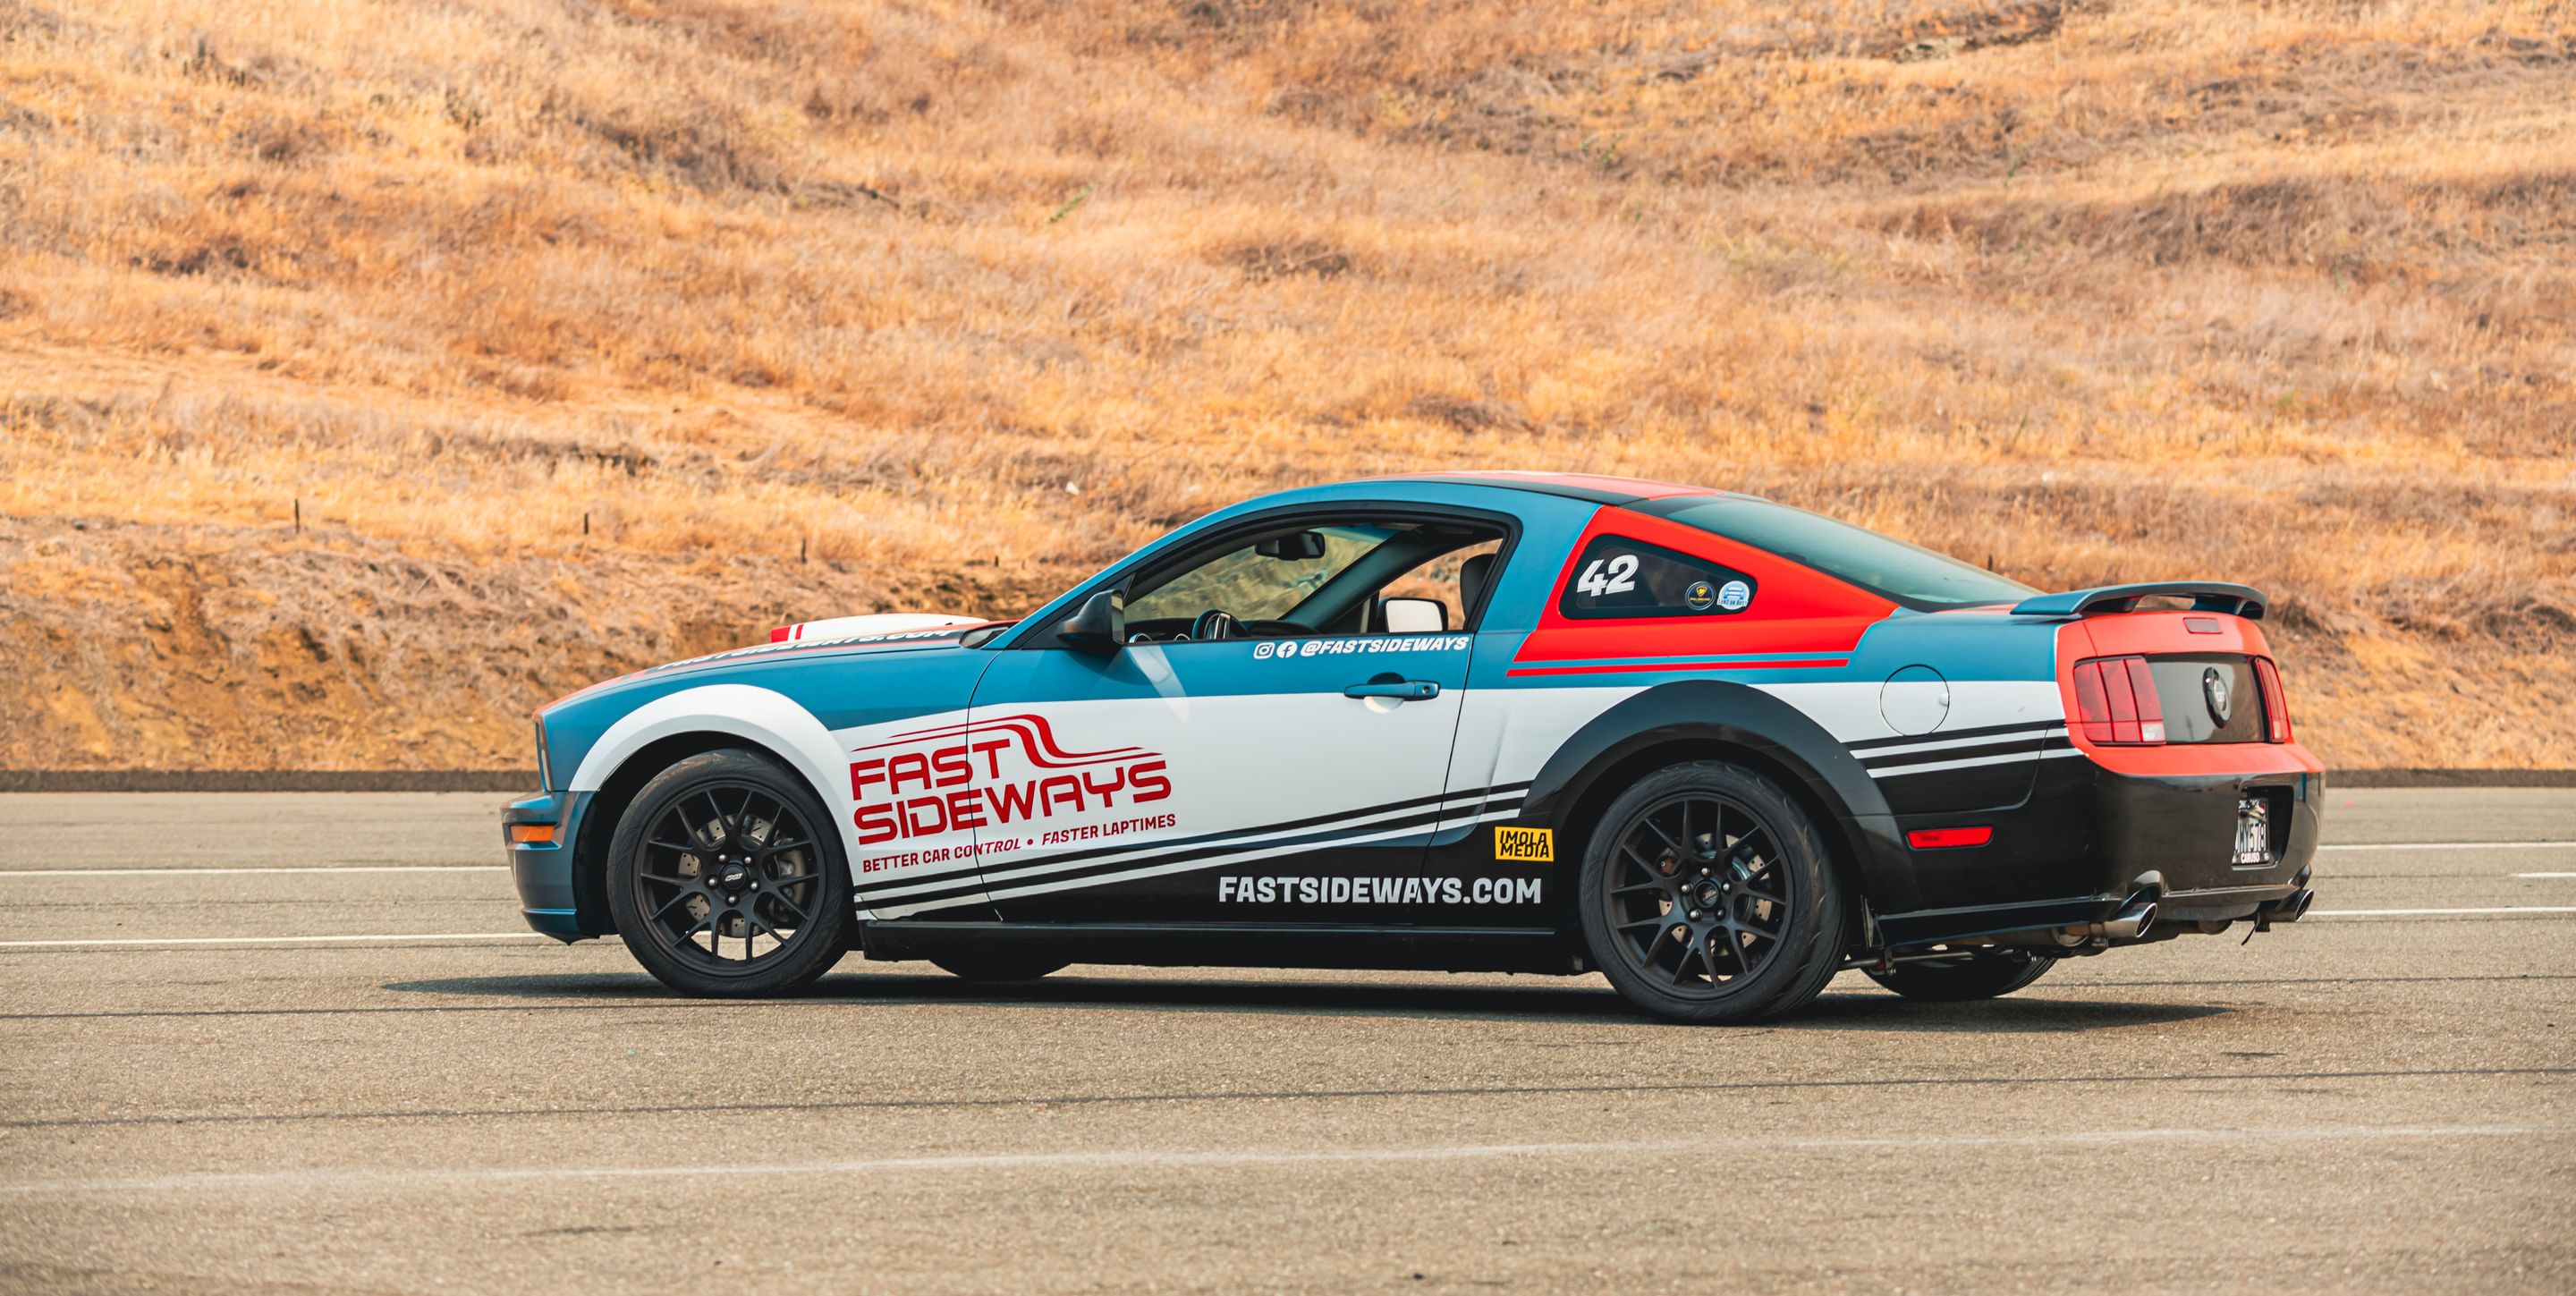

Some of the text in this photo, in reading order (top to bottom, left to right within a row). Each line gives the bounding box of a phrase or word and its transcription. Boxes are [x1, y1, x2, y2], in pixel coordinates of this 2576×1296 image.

[1577, 554, 1640, 597] 42
[1301, 636, 1470, 657] @FASTSIDEWAYS
[850, 738, 1011, 800] FAST
[853, 759, 1172, 845] SIDEWAYS
[863, 814, 1176, 873] BETTER CAR CONTROL FASTER LAPTIMES
[1500, 830, 1547, 846] IMOLA
[1500, 843, 1549, 859] MEDIA
[1218, 876, 1542, 904] FASTSIDEWAYS.COM
